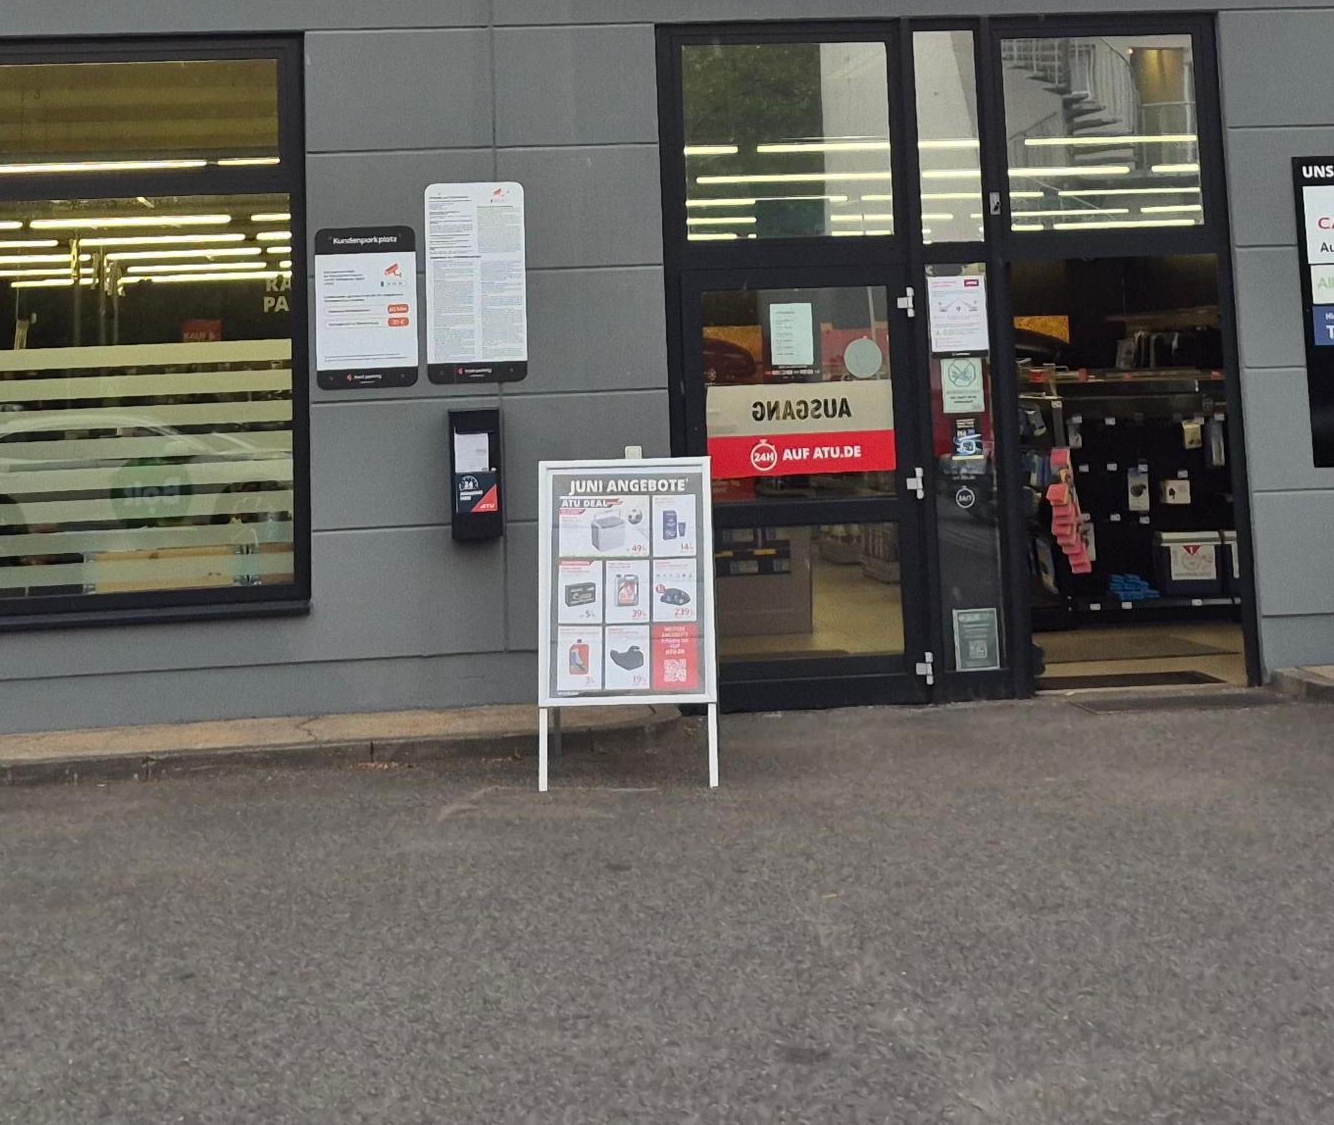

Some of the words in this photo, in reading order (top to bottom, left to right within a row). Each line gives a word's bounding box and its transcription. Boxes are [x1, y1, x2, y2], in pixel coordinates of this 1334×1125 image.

[753, 452, 775, 463] 24H
[782, 447, 810, 461] AUF
[812, 445, 862, 460] ATU.DE
[568, 479, 603, 495] JUNI
[561, 499, 583, 508] ATU
[583, 499, 608, 508] DEAL
